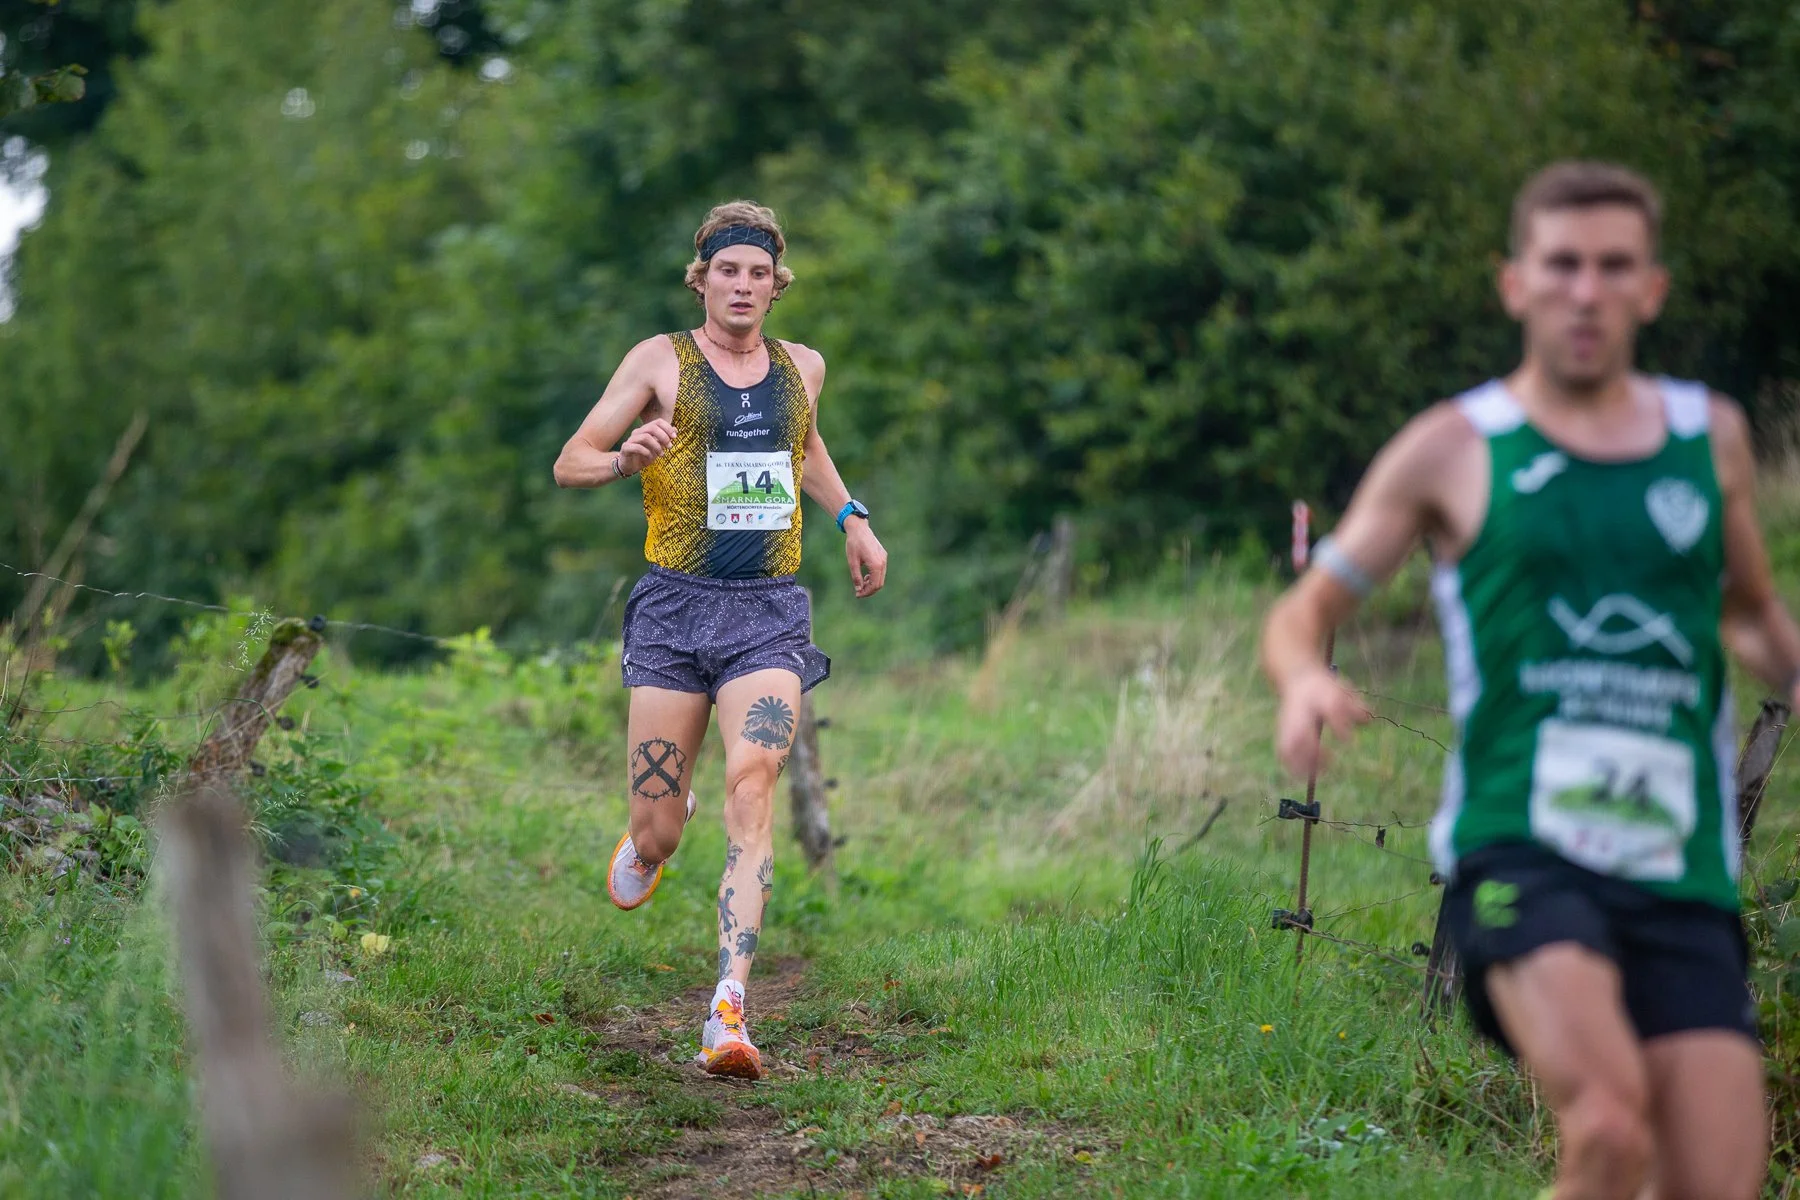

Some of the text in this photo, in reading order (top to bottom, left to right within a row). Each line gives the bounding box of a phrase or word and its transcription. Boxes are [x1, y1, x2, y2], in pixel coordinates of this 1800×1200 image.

[726, 428, 770, 439] run2gether
[736, 470, 775, 494] 14
[765, 496, 793, 504] GORA
[761, 741, 773, 750] ME
